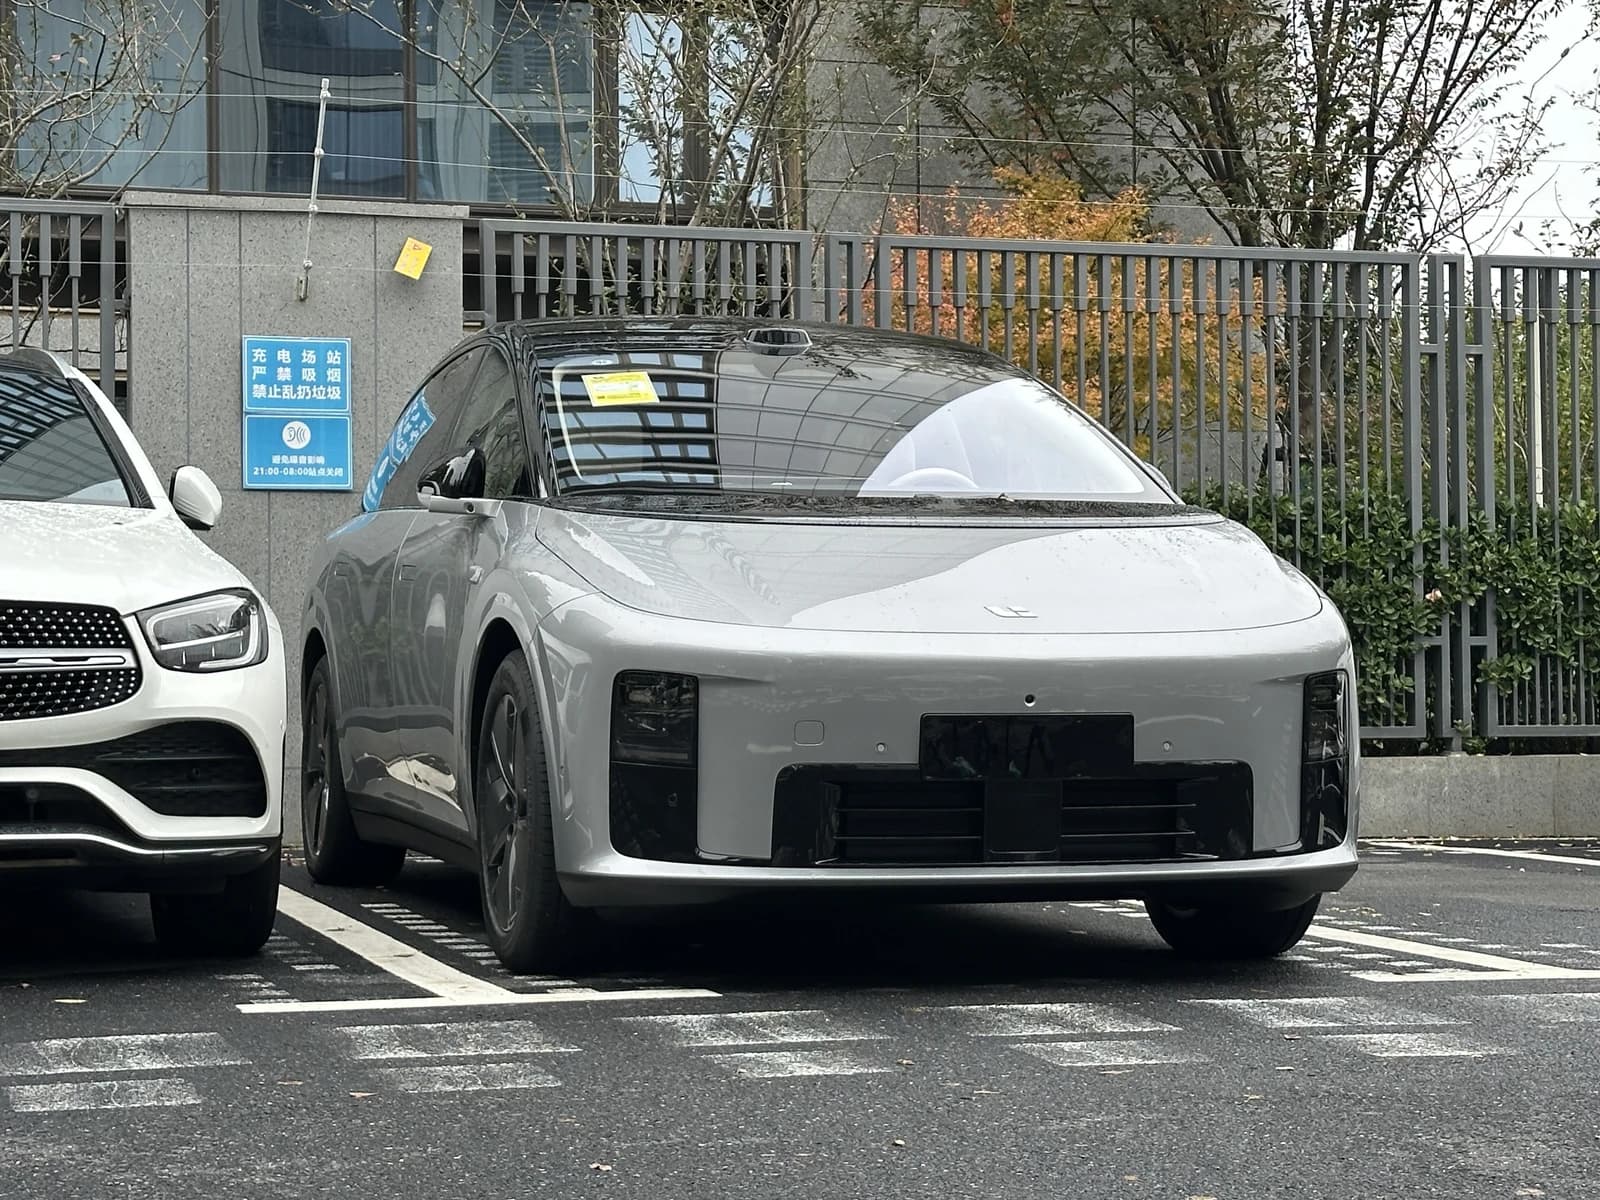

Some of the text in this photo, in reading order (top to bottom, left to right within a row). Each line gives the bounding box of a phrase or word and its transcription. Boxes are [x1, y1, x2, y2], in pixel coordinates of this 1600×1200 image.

[252, 348, 341, 364] 充电场站
[252, 366, 341, 382] 严禁吸烟
[252, 384, 341, 400] 禁止乱扔垃圾
